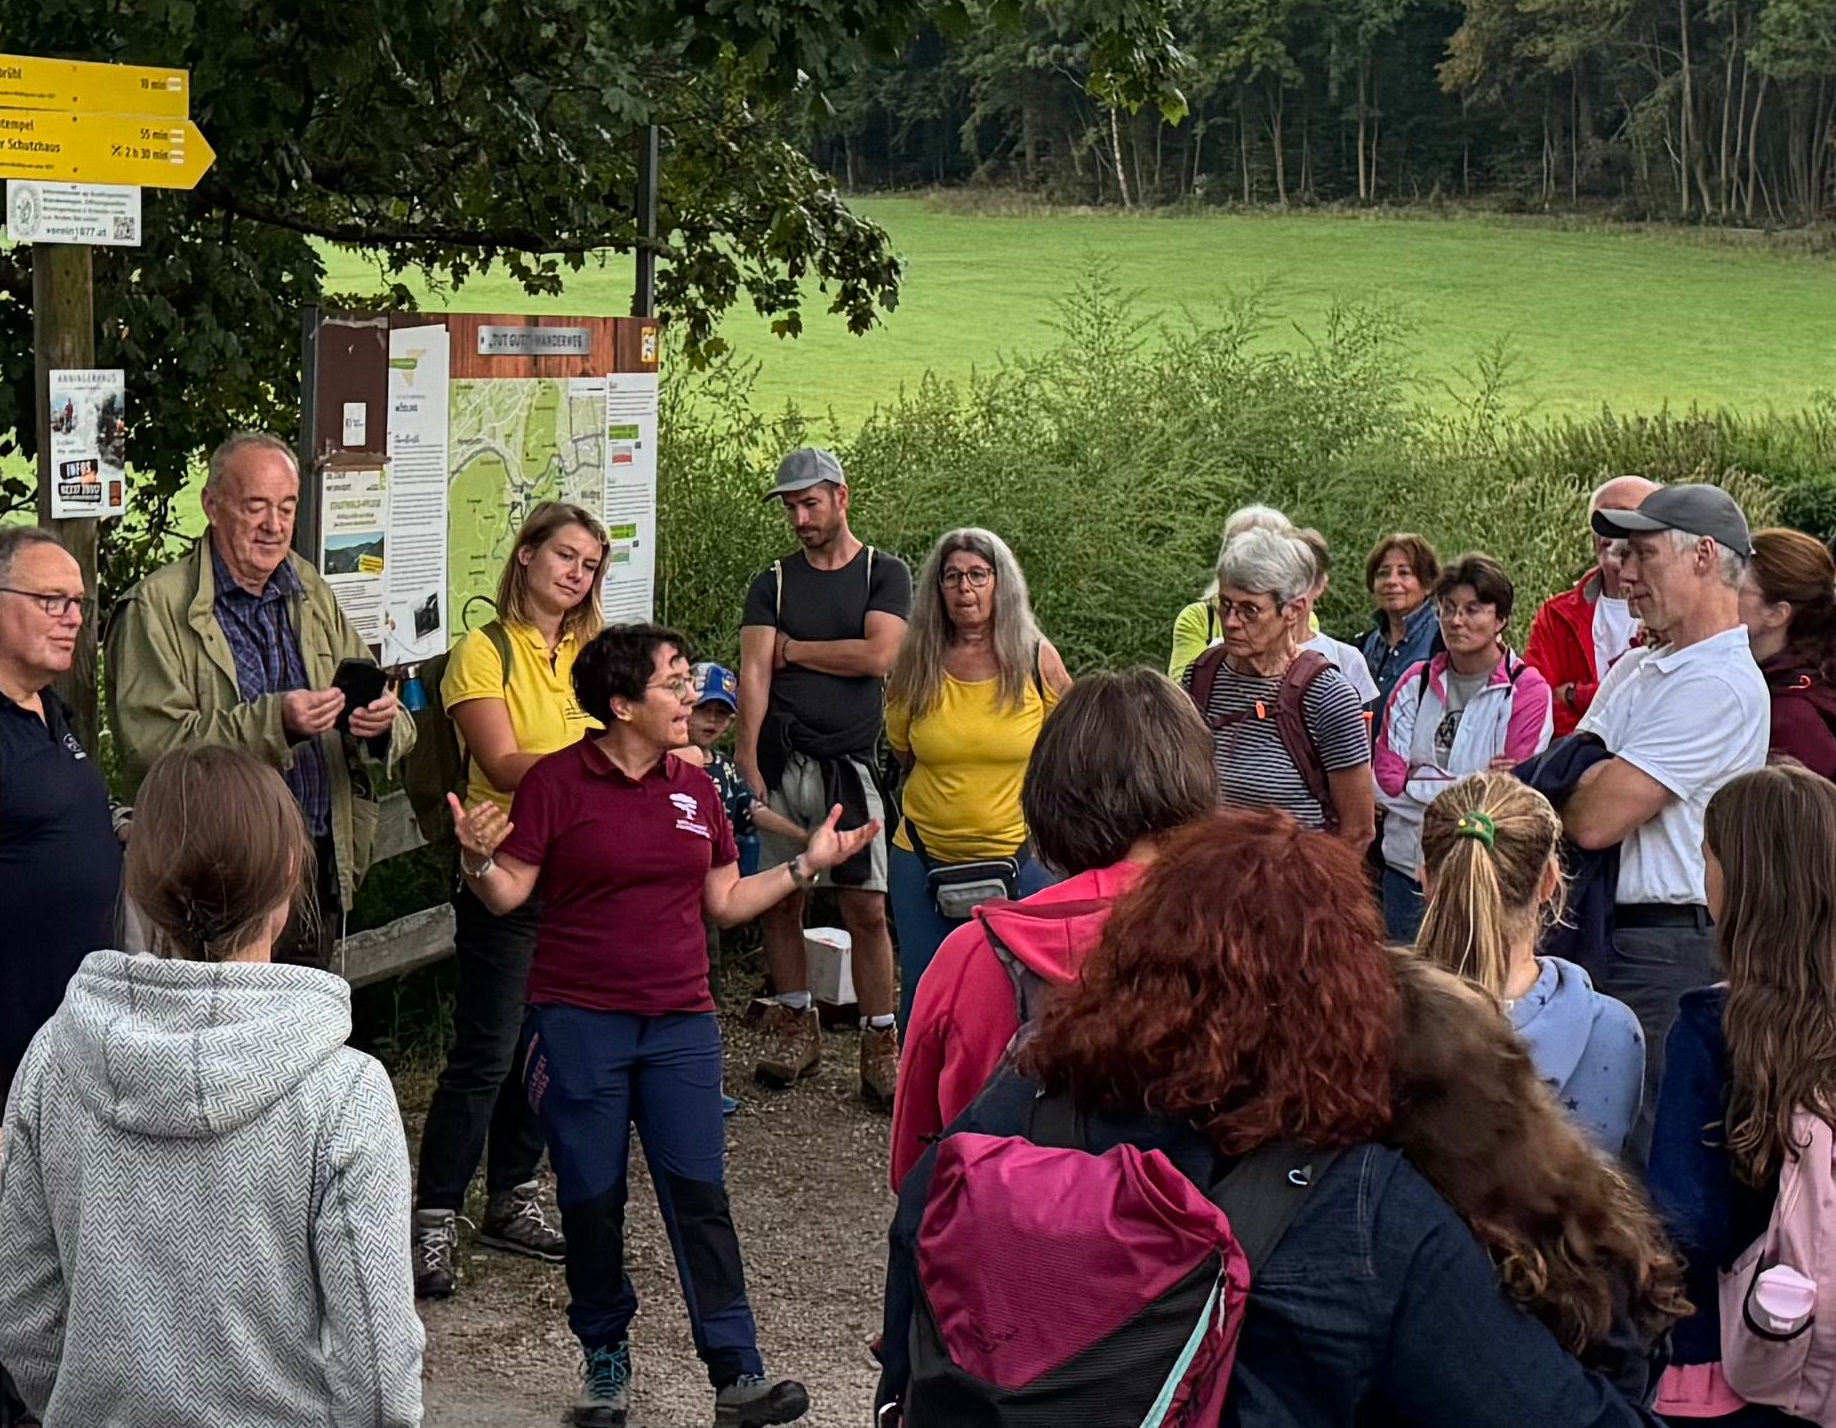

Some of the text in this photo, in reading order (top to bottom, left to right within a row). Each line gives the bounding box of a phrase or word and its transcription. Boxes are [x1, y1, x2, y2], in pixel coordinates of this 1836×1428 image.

[150, 79, 167, 90] min
[152, 129, 168, 140] min
[8, 138, 61, 153] Schutzhaus
[152, 149, 168, 160] min
